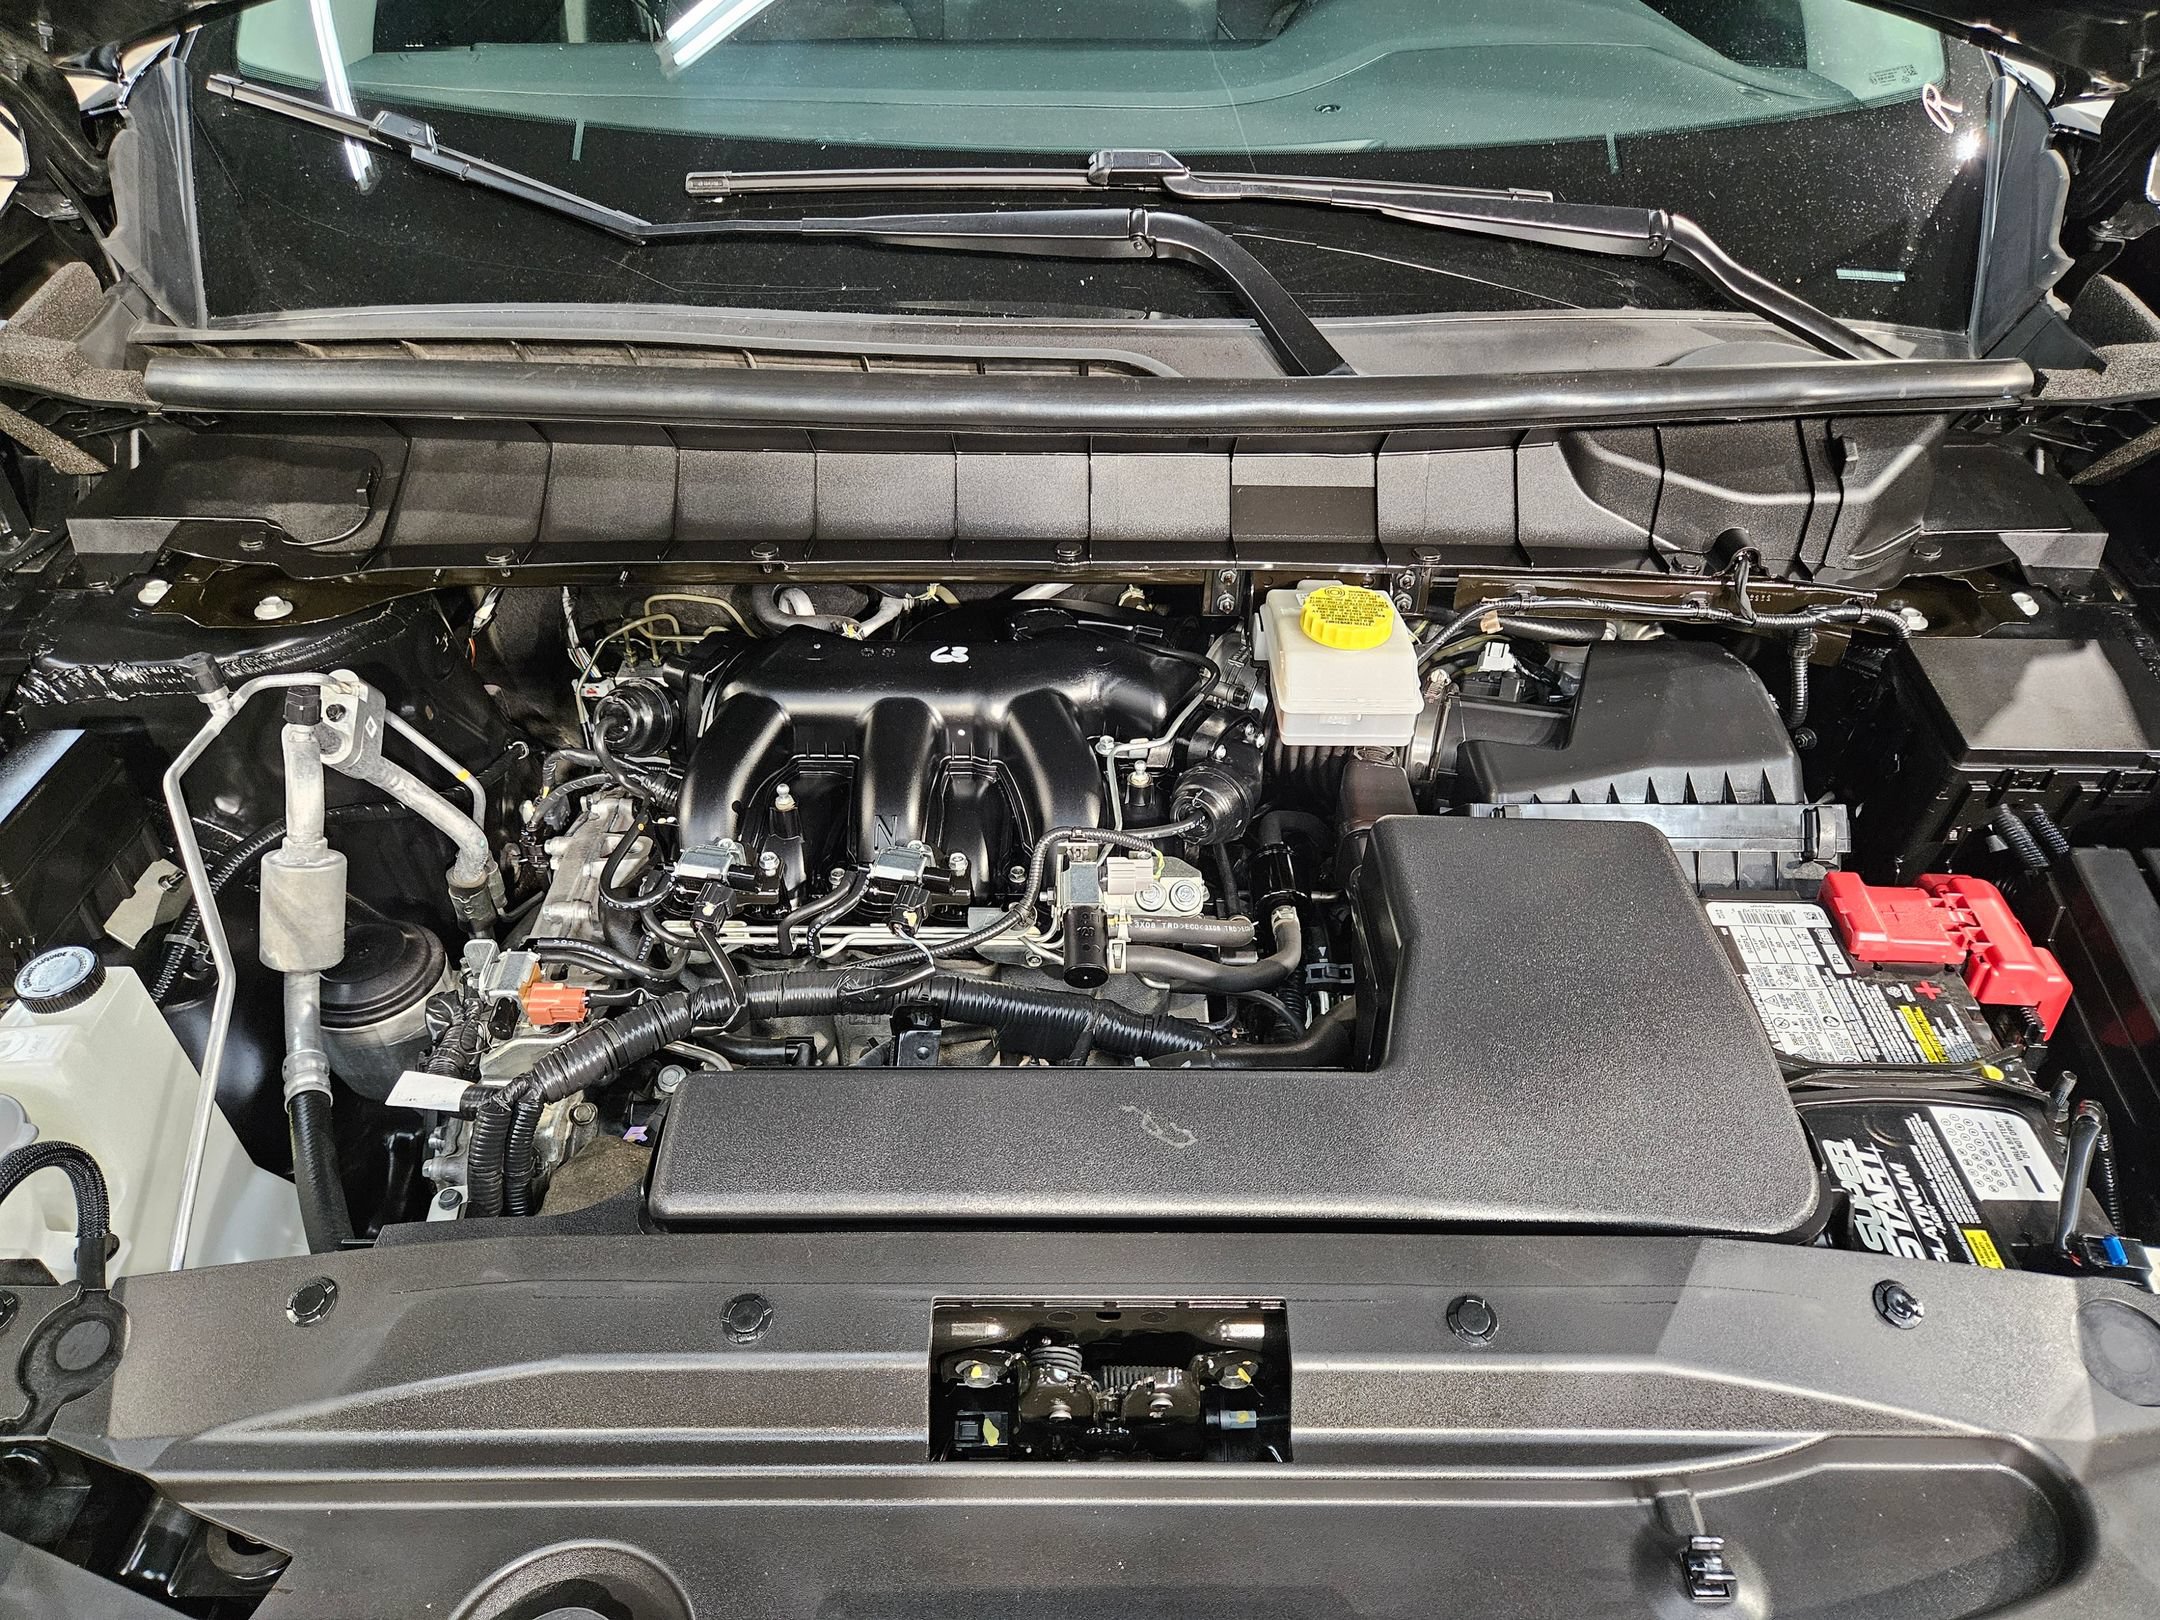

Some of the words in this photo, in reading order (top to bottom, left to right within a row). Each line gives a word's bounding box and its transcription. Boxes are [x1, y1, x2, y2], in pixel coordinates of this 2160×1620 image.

[1828, 952, 1844, 965] Pb
[1994, 1120, 2014, 1144] BATTERY
[2011, 1136, 2025, 1149] NOT
[2008, 1146, 2024, 1161] VRLA
[2018, 1149, 2031, 1158] DO
[1822, 1138, 1885, 1253] SUPER
[1843, 1138, 1927, 1259] START
[1926, 1205, 1948, 1232] AGM
